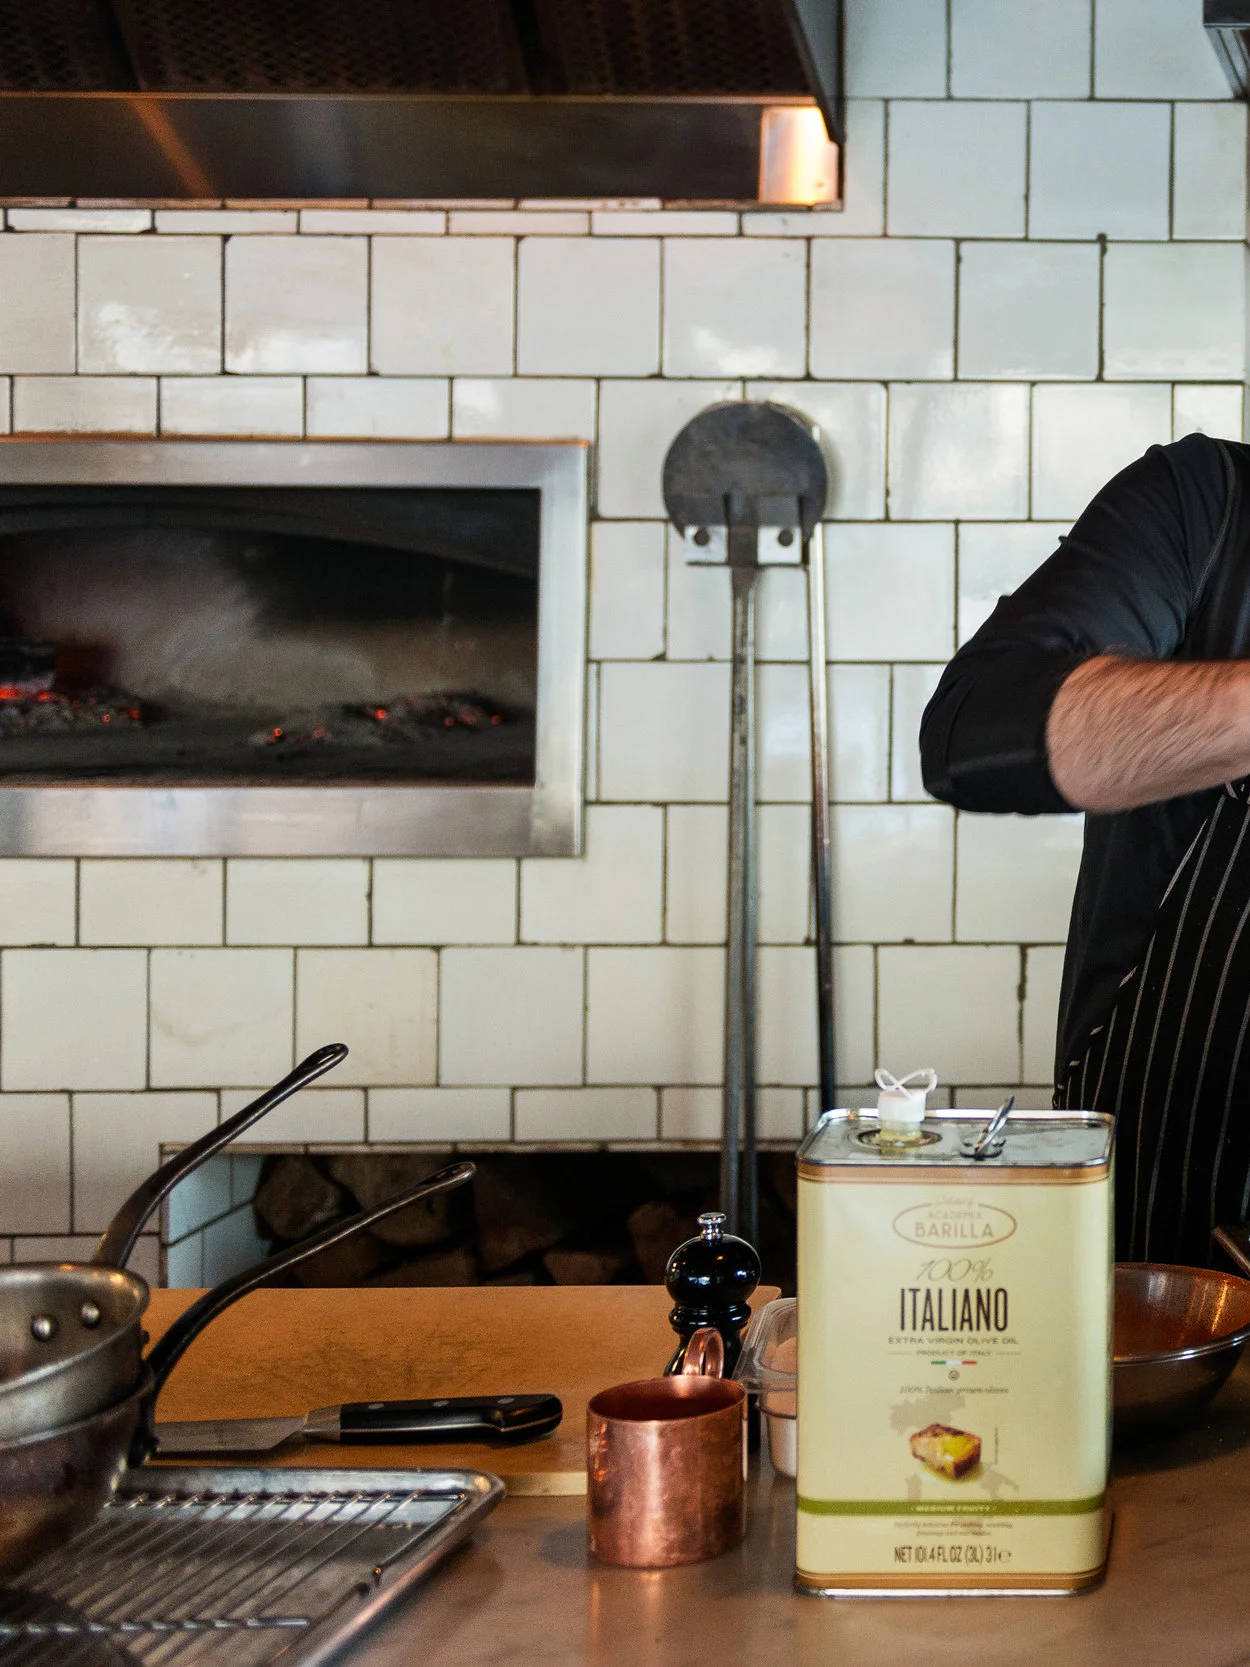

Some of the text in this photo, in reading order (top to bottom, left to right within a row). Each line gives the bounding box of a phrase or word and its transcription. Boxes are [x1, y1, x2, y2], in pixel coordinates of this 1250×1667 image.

[915, 1222, 994, 1238] BARILLA
[916, 1258, 994, 1281] 100%
[901, 1287, 1008, 1331] ITALIANO
[895, 1546, 912, 1562] NET
[937, 1546, 948, 1562] FL
[949, 1546, 962, 1562] OZ
